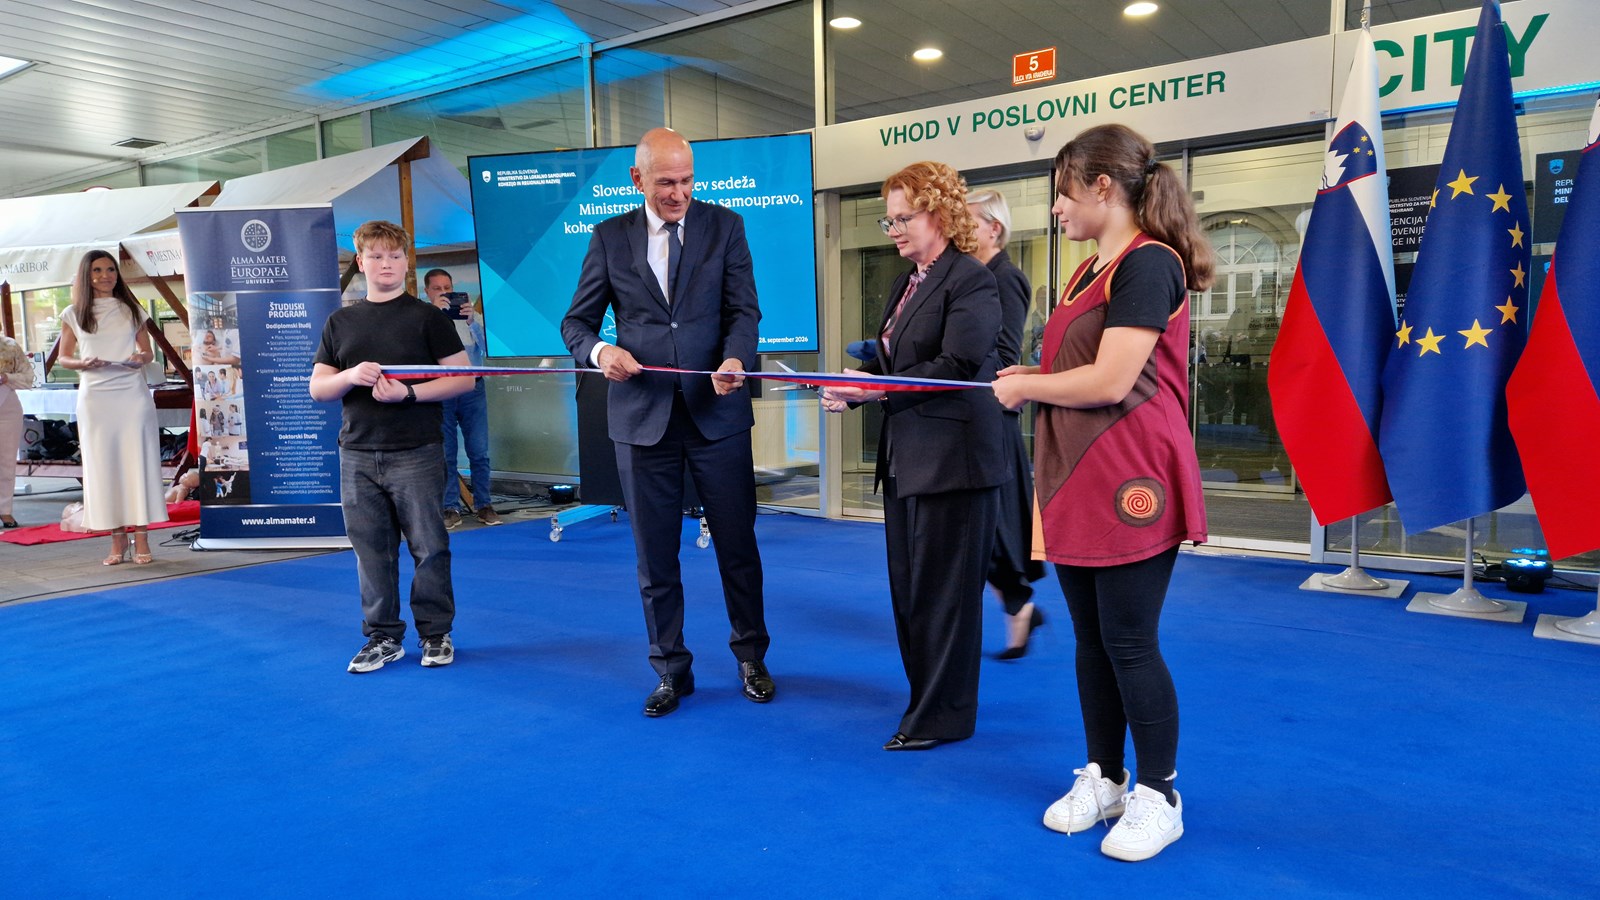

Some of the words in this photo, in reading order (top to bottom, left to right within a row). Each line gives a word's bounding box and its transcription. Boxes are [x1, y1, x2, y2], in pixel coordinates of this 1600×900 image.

[1373, 13, 1550, 98] CITY
[1029, 56, 1038, 72] 5
[880, 120, 940, 146] VHOD
[947, 116, 961, 136] V
[972, 92, 1096, 132] POSLOVNI
[1110, 71, 1226, 109] CENTER
[592, 184, 644, 197] Slovesn
[711, 176, 756, 190] sedeža
[718, 194, 803, 208] samoupravo,
[1392, 226, 1426, 236] OVENIJE
[230, 256, 254, 264] ALMA
[256, 255, 287, 264] MATER
[5, 260, 49, 274] MARIBOR
[231, 266, 288, 278] EUROPAEA
[270, 301, 305, 311] ŠTUDIJSKI
[268, 310, 307, 318] PROGRAMI
[767, 336, 794, 344] september
[241, 516, 316, 525] www.almamater.si
